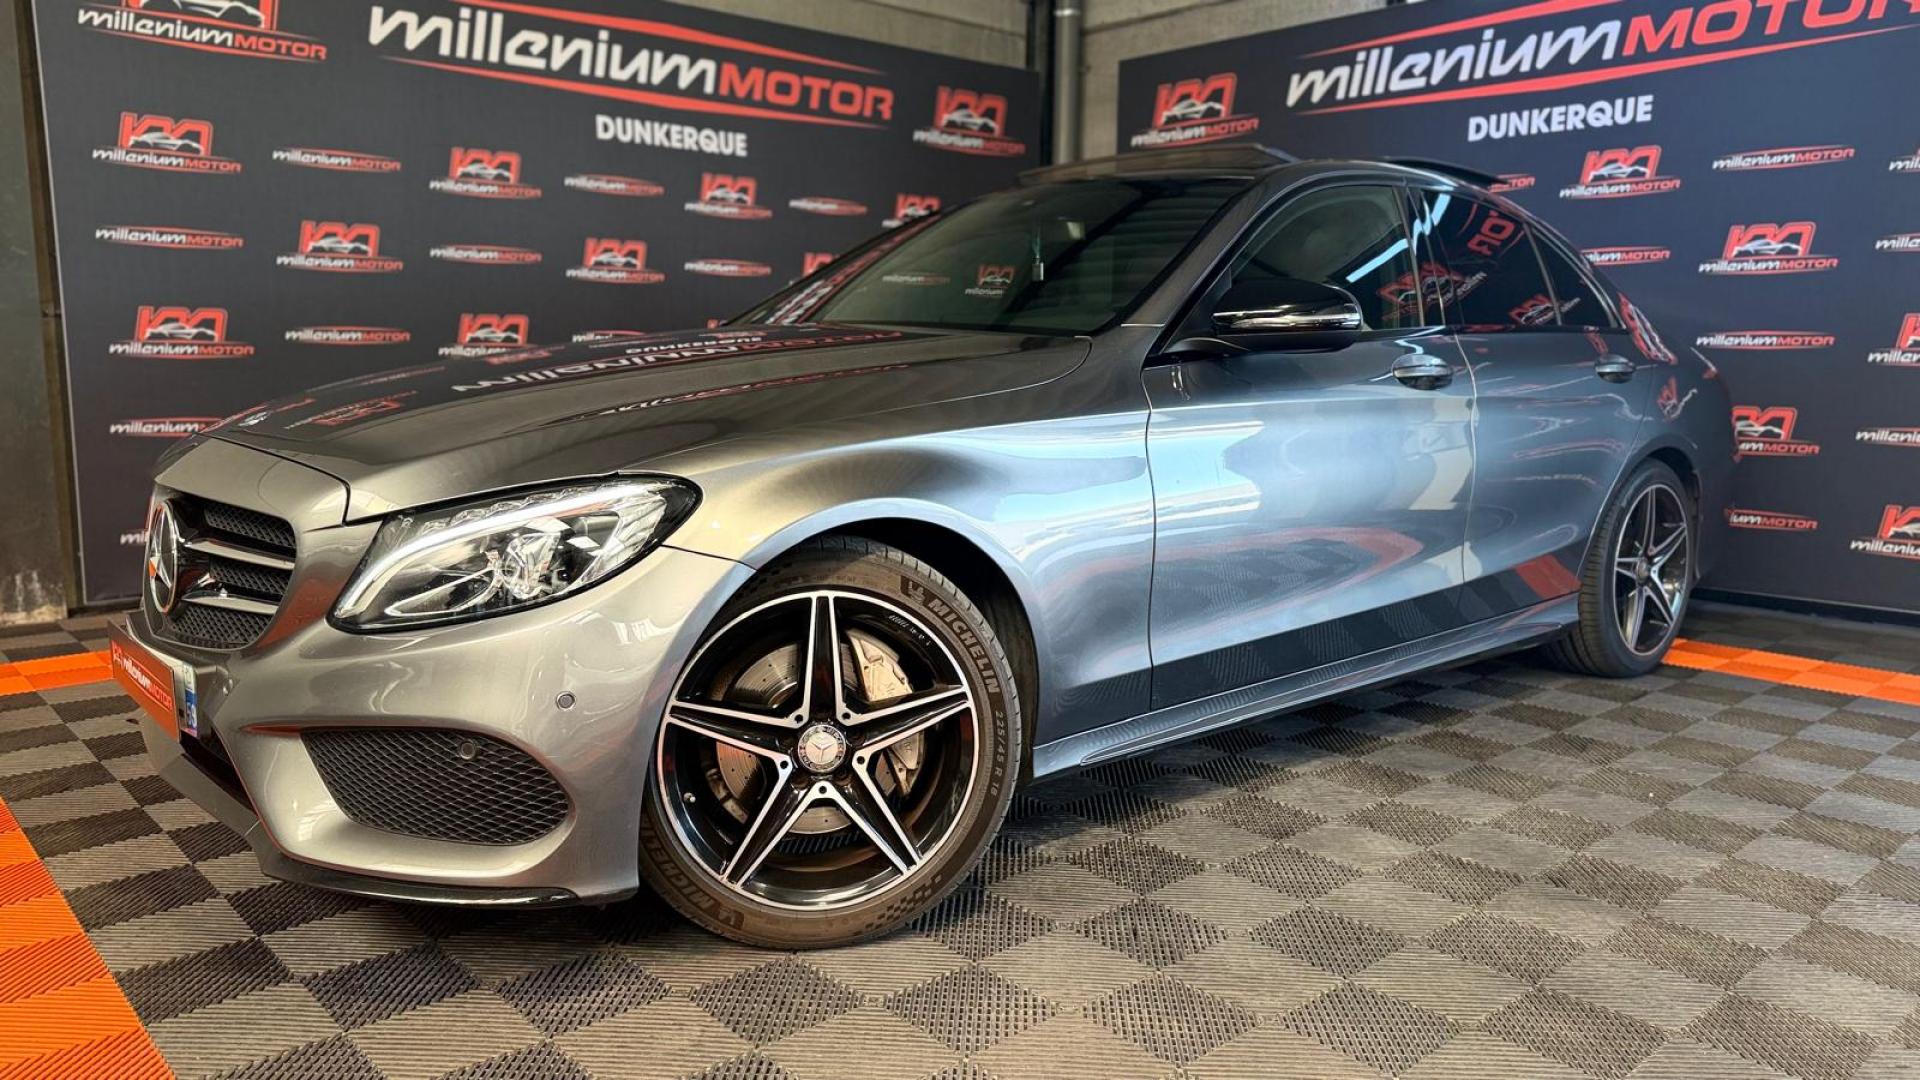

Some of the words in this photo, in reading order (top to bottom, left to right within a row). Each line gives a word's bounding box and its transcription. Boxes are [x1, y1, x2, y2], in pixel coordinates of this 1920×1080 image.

[596, 114, 748, 157] DUNKERQUE
[1467, 95, 1654, 142] DUNKERQUE
[908, 598, 1001, 695] MICHELIN
[994, 710, 1006, 763] 225/45
[993, 766, 1003, 777] R
